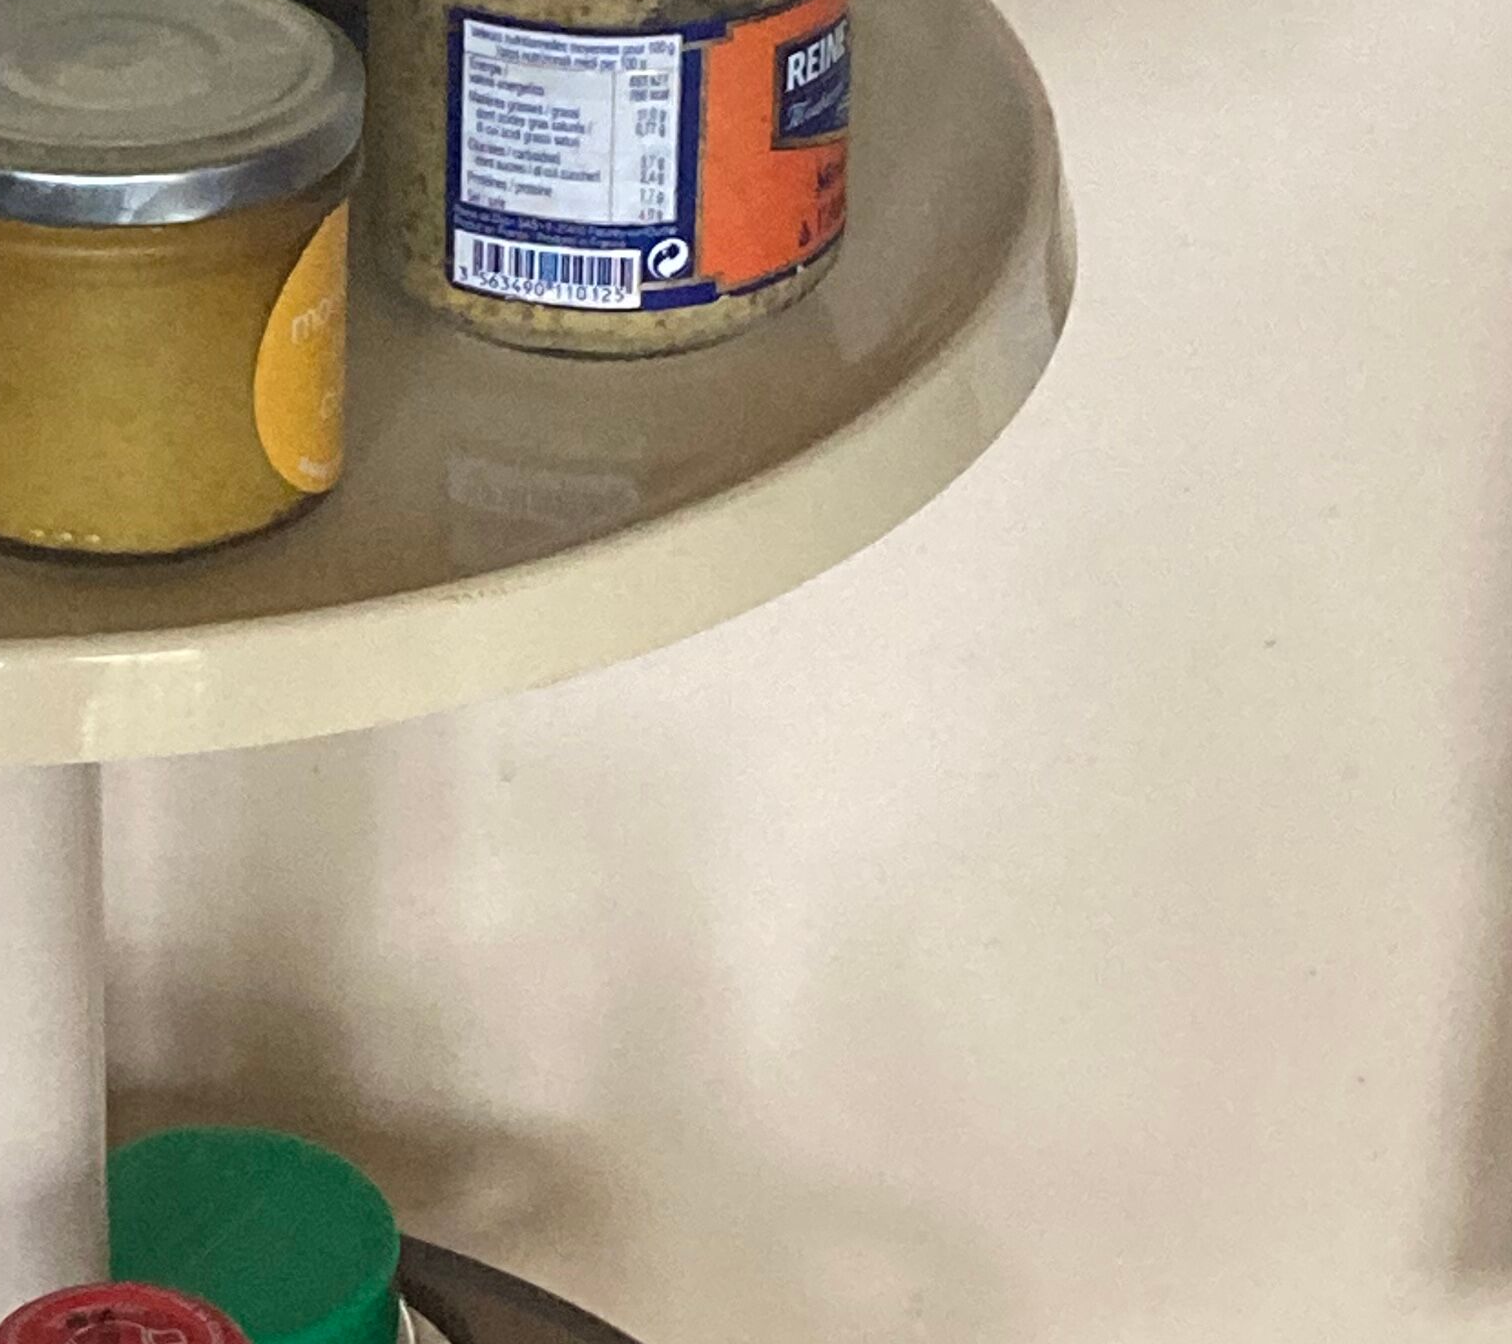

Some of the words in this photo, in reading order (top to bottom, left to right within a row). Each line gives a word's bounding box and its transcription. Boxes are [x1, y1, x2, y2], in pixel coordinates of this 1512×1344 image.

[458, 265, 468, 282] 3
[479, 271, 546, 298] 563490
[555, 284, 625, 304] 110125
